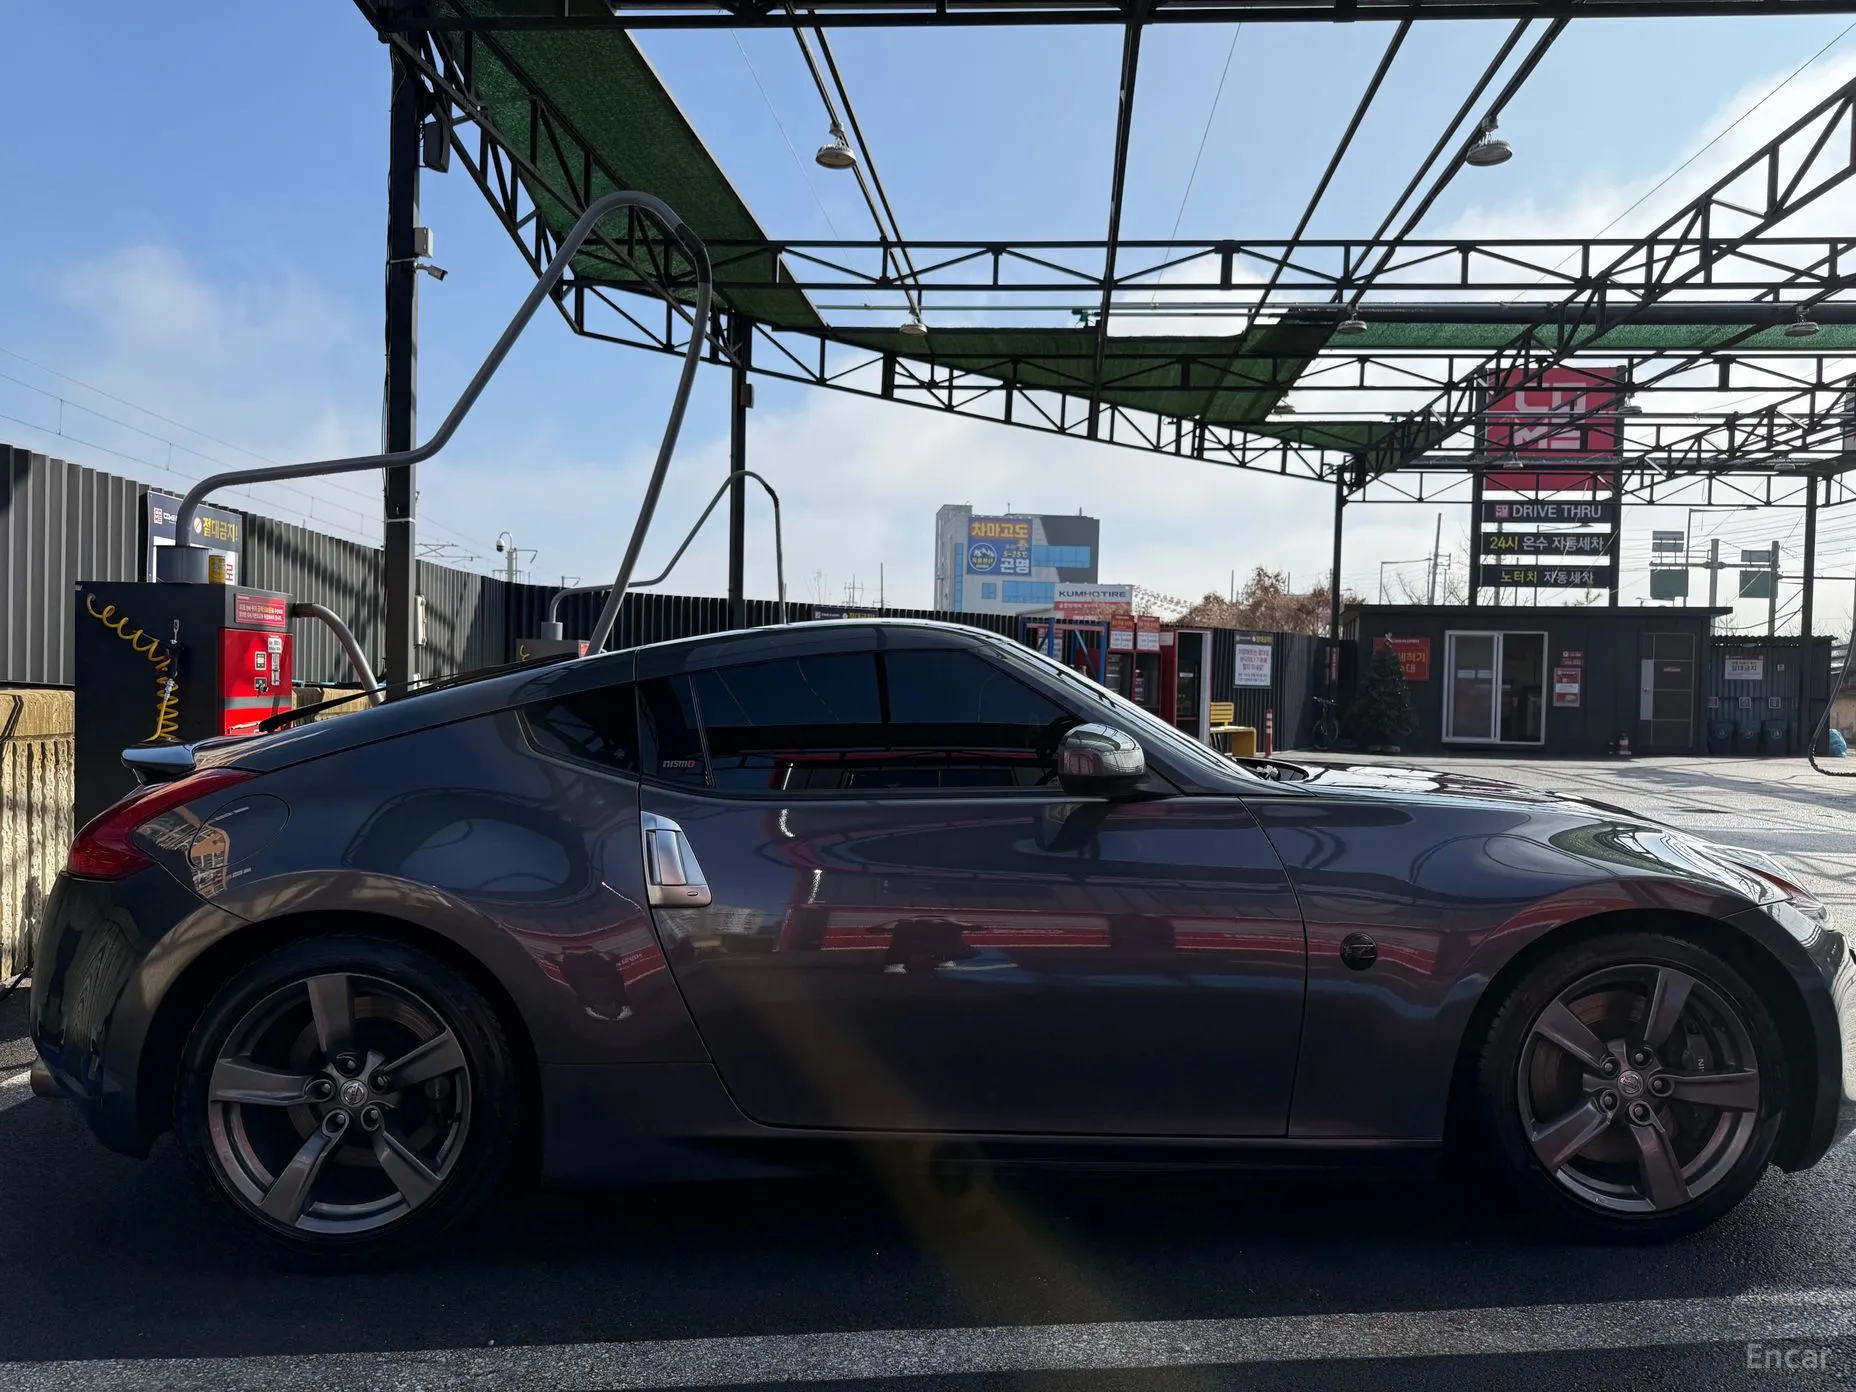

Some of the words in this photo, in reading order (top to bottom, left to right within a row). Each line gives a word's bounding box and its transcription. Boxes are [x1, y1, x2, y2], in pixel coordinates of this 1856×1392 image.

[1512, 505, 1557, 518] DRIVE
[1561, 505, 1602, 518] THRU
[971, 522, 1029, 538] 차마고도
[1490, 536, 1519, 550] 24시
[1522, 536, 1549, 551] 온수
[1551, 536, 1604, 551] 자동세차
[1000, 557, 1030, 574] 곤명
[1501, 570, 1538, 584] 노터치
[1543, 570, 1594, 585] 자동세차
[1058, 590, 1100, 598] KUMHO
[1101, 590, 1127, 598] TIRE
